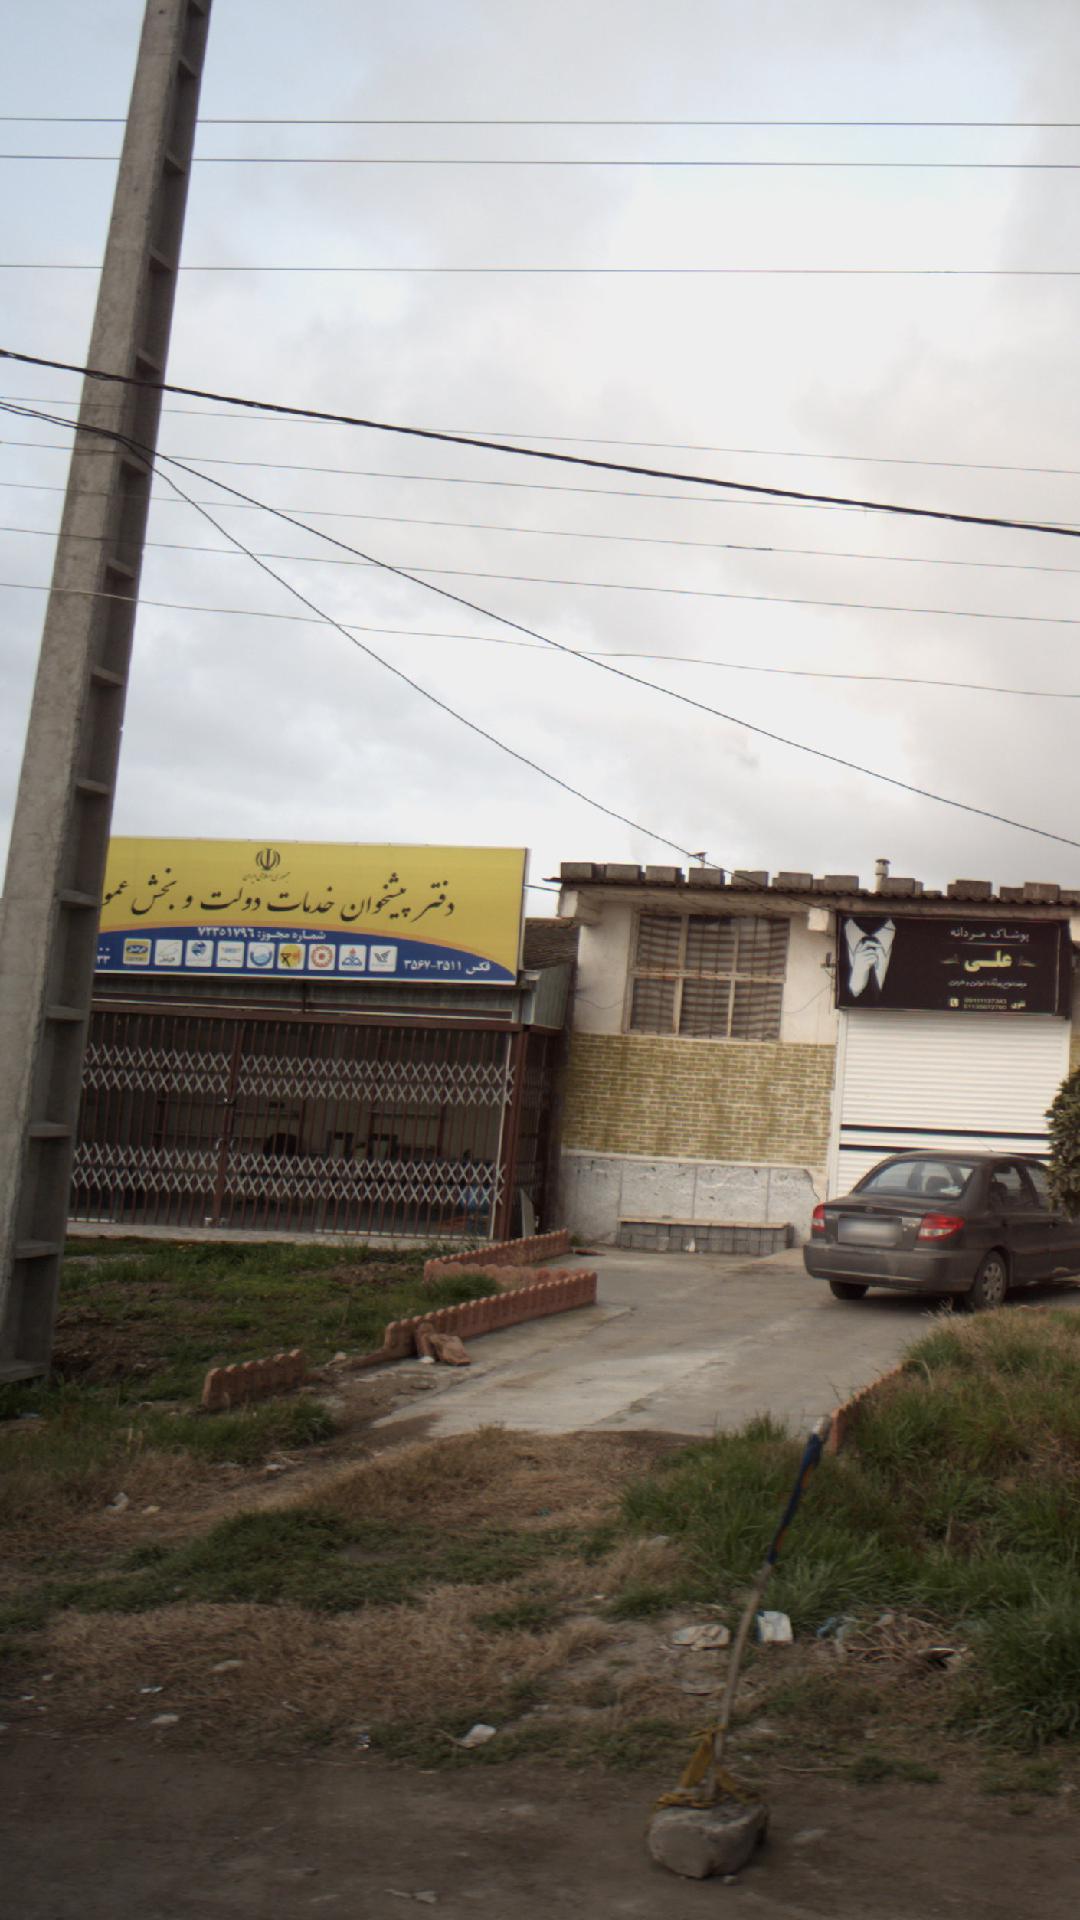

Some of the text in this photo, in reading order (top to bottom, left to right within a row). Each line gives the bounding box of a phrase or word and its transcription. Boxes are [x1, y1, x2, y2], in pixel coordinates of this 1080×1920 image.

[131, 868, 177, 915] بخش
[182, 895, 193, 909] و
[201, 887, 261, 912] دولت
[267, 886, 335, 914] خدمات
[340, 872, 411, 922] پیشخوان
[411, 880, 455, 923] دفتر
[292, 930, 327, 942] شماره
[950, 927, 1030, 943] پوشاک مردانه
[465, 962, 491, 975] فکس
[964, 950, 1012, 972] علی
